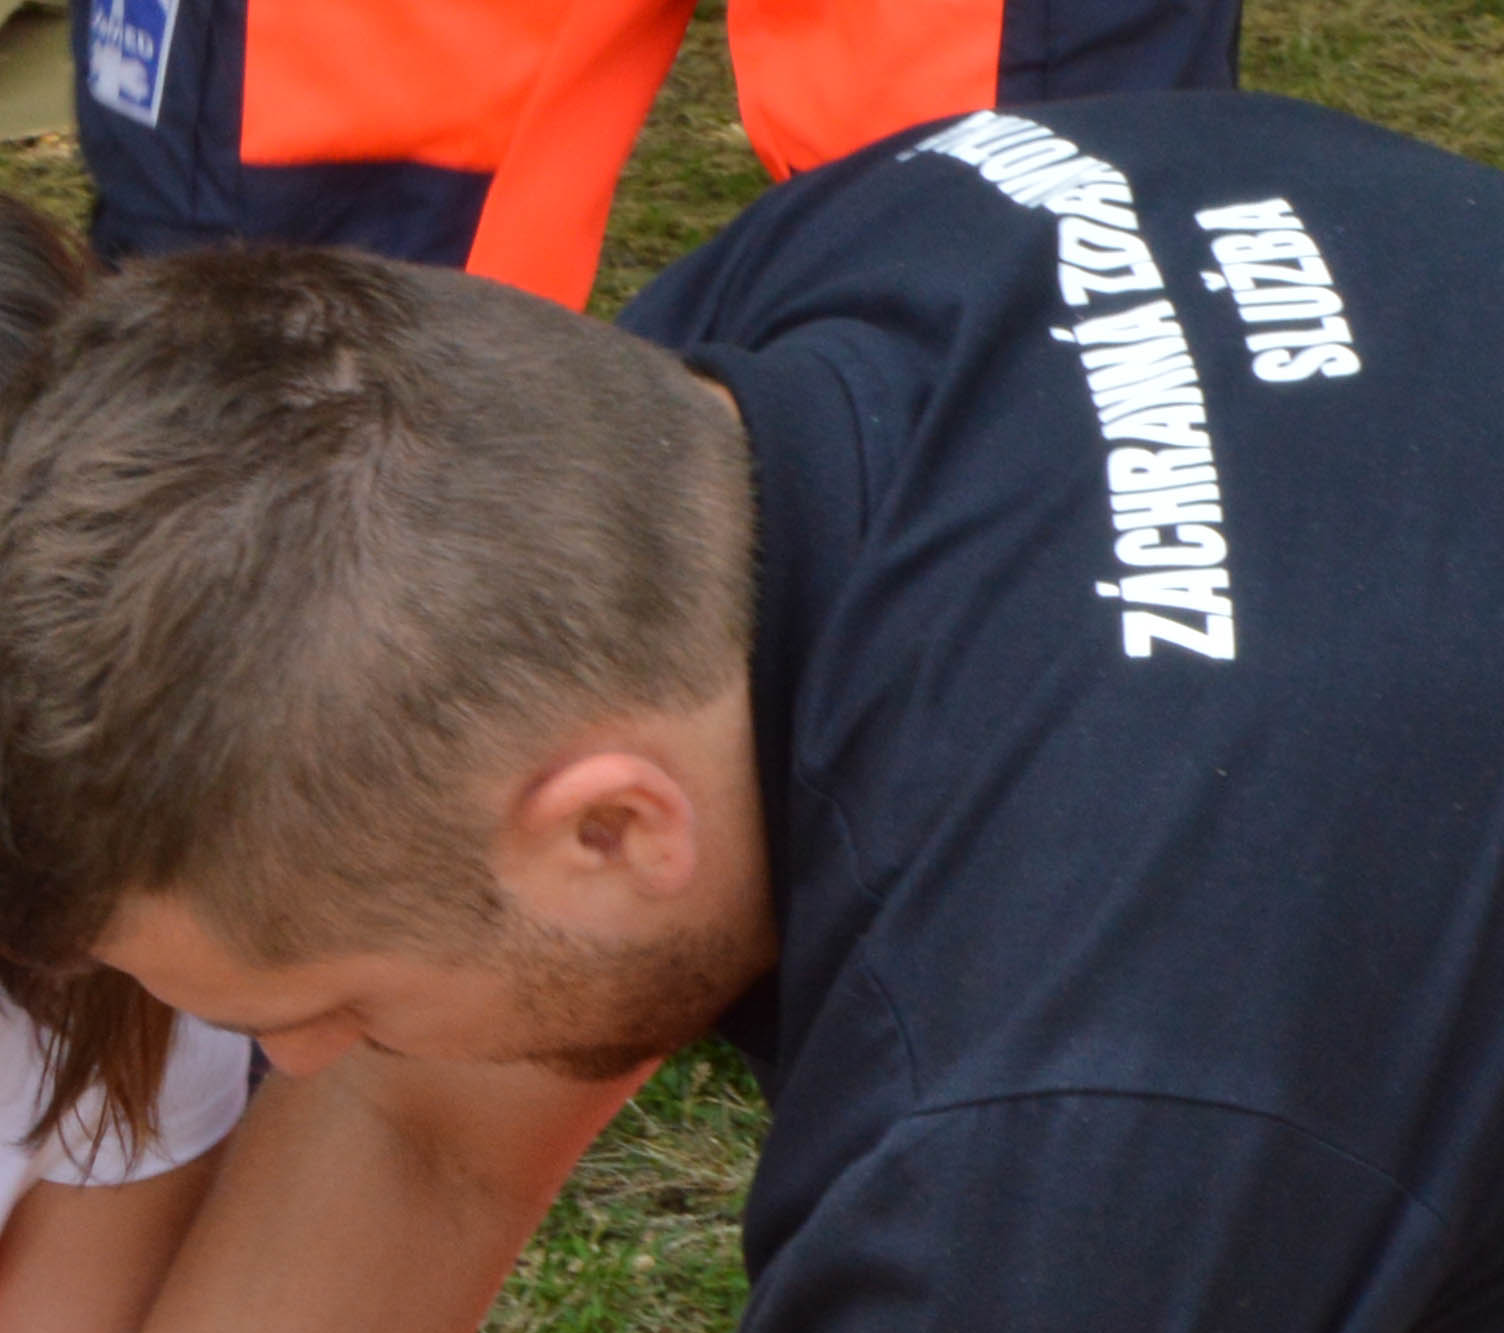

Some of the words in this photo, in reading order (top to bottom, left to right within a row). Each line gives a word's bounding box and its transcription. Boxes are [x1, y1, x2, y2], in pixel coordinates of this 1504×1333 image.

[895, 109, 1166, 307] ZDRAVOT
[1194, 197, 1362, 383] SLUŽBA
[1050, 298, 1236, 661] ZÁCHRANNÁ
